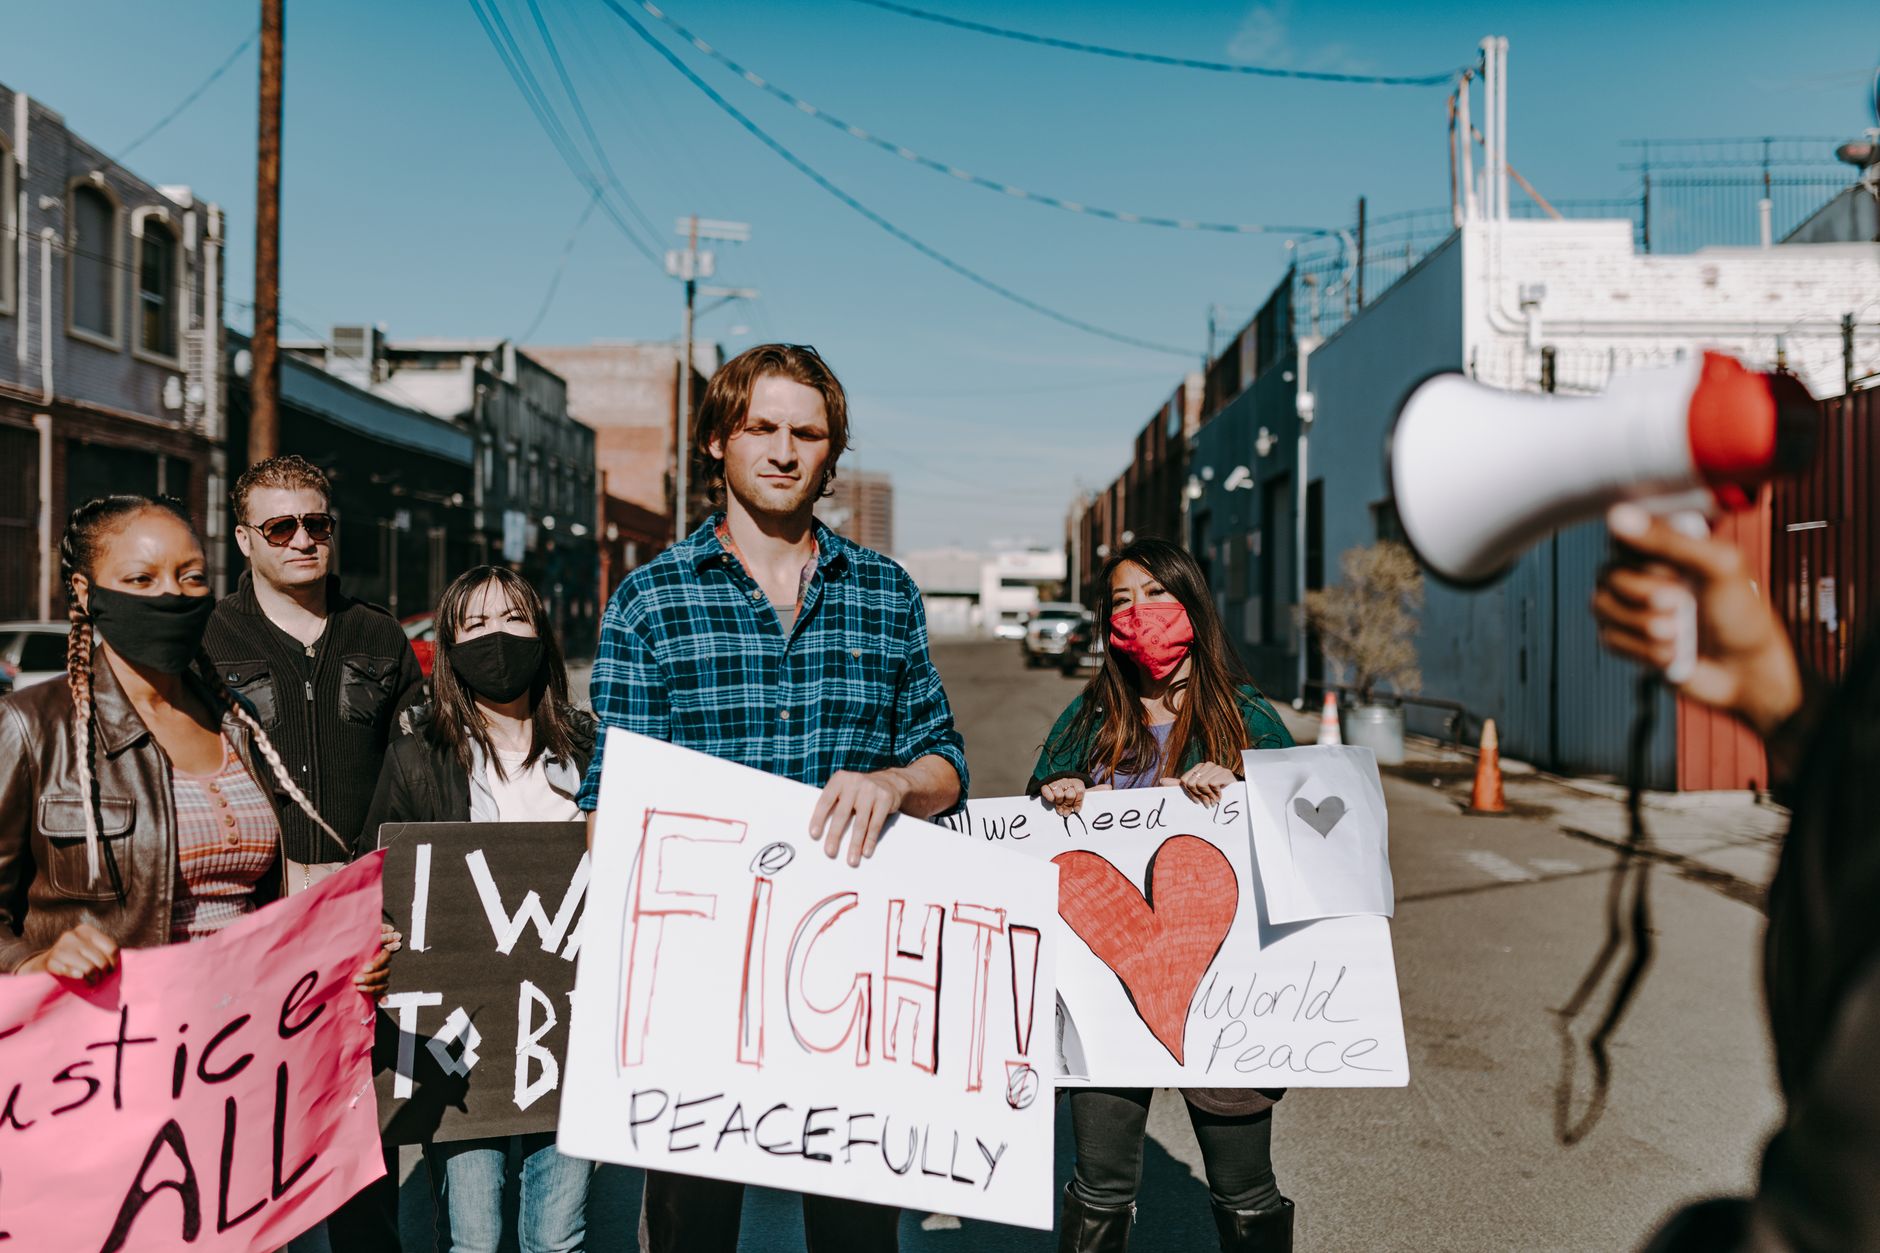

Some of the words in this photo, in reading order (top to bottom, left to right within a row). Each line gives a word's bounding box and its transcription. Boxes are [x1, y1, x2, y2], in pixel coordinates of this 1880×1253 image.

[982, 814, 1031, 841] we
[1062, 797, 1167, 839] need
[410, 843, 432, 953] I
[379, 990, 483, 1099] TO
[512, 979, 577, 1112] B
[1193, 961, 1359, 1024] World
[0, 970, 327, 1131] ustice
[1205, 1020, 1393, 1075] Peace
[99, 1061, 318, 1253] ALL
[629, 1088, 1008, 1191] PEACEFULLY
